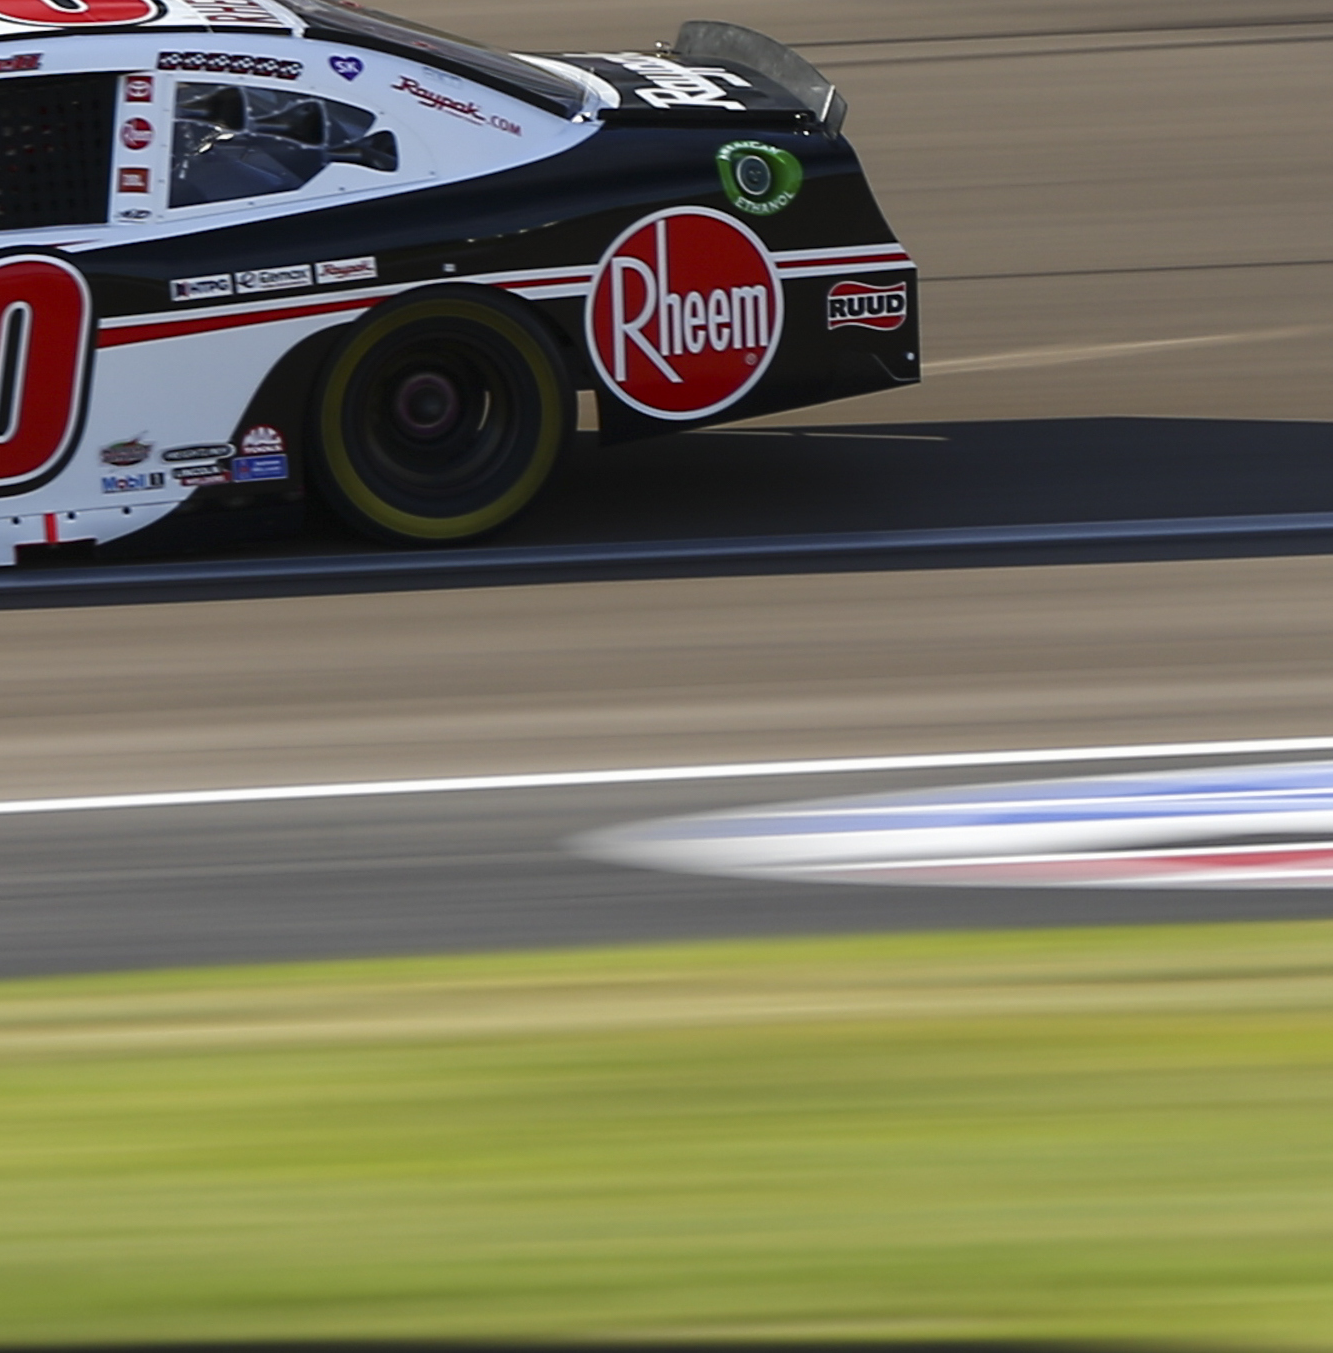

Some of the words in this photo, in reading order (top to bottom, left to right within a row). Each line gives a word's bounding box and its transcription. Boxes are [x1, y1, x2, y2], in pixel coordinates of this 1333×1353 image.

[734, 190, 797, 216] ETHANOL
[610, 218, 769, 384] Rheem
[829, 292, 906, 319] RUUD
